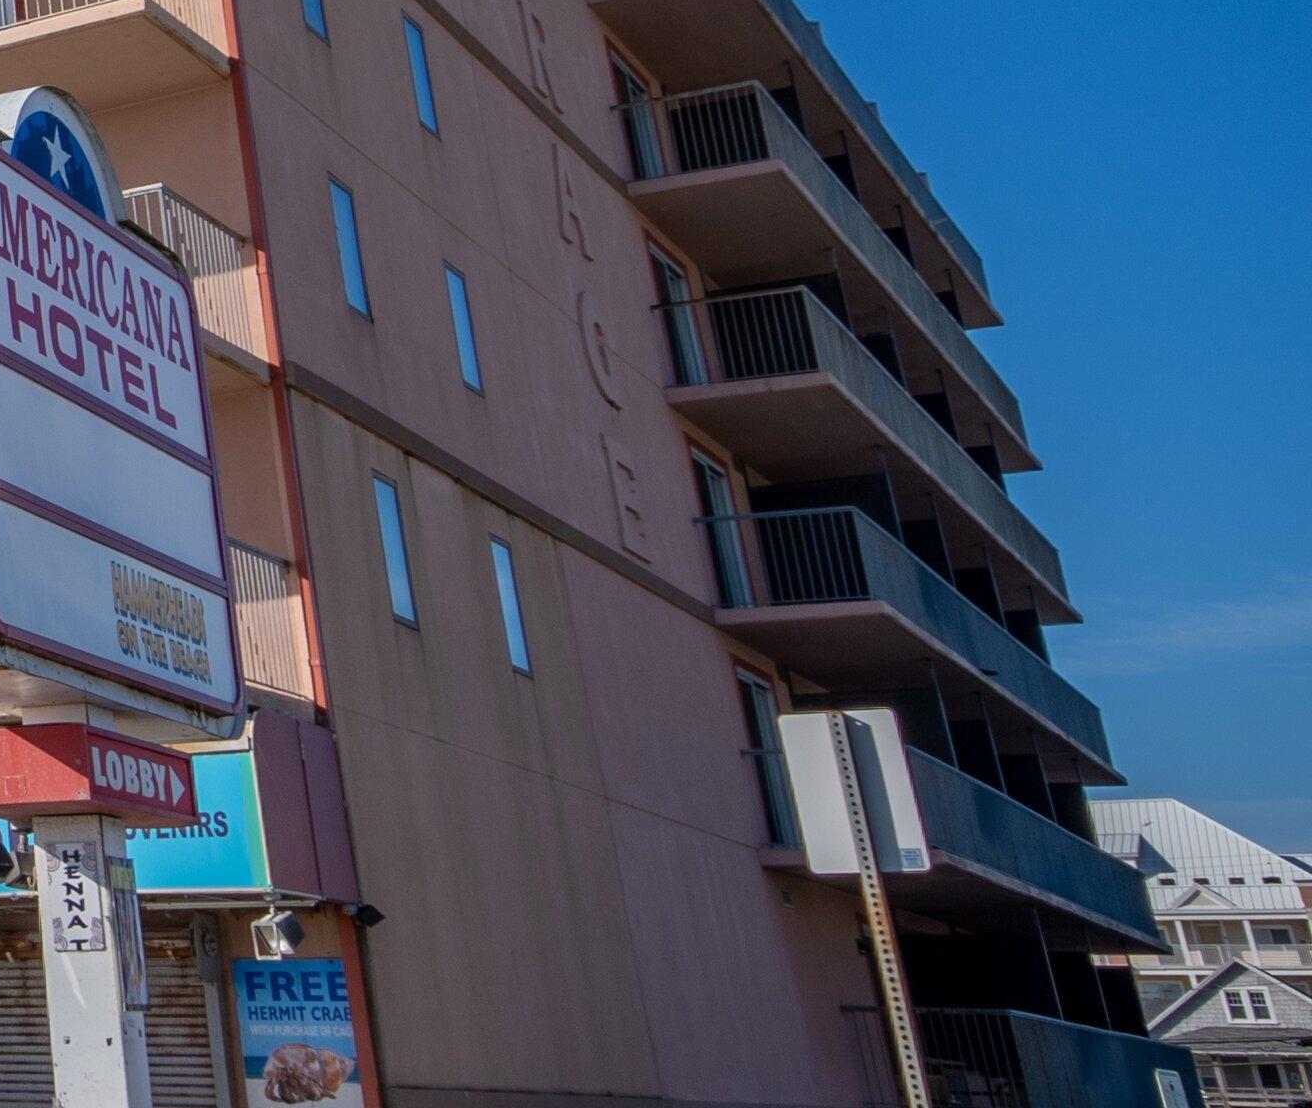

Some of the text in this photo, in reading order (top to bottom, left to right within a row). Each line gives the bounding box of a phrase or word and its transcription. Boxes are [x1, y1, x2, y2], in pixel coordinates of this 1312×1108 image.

[6, 277, 178, 430] HOTEL
[110, 560, 207, 649] HAMMERHEADS
[117, 619, 212, 685] ON THE BEACH
[91, 747, 166, 802] LOBBY
[62, 849, 89, 929] HENNA
[244, 971, 349, 1002] FREE
[247, 1006, 306, 1022] HERMIT
